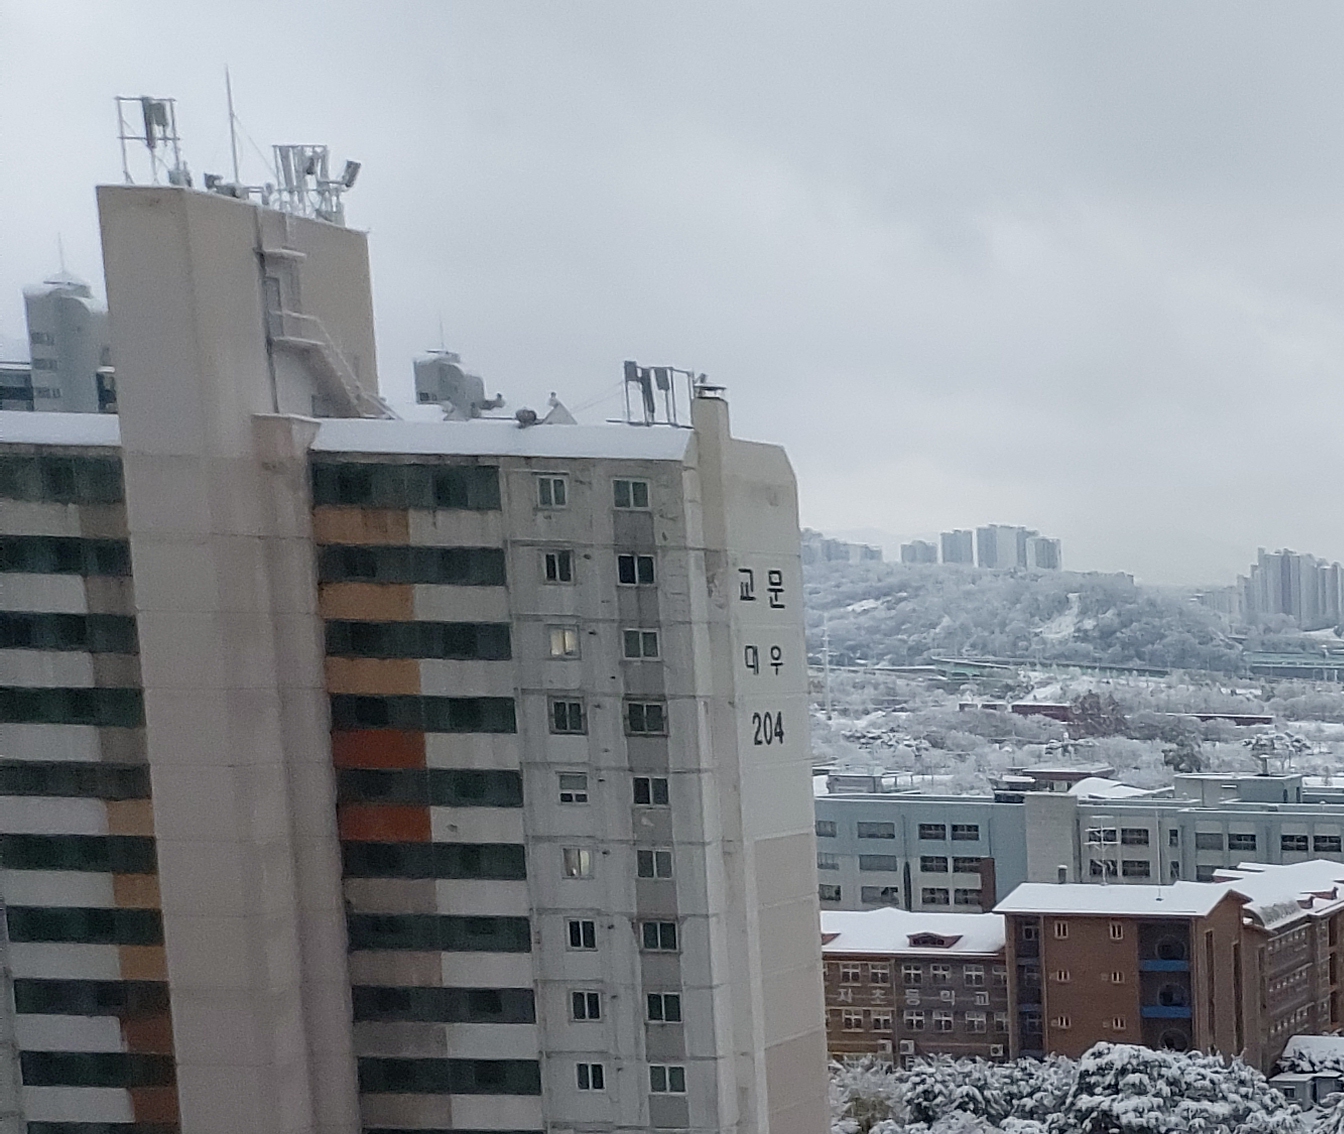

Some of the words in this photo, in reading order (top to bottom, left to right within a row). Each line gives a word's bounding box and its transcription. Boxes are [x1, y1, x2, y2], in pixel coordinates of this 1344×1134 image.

[738, 568, 785, 609] 교문
[745, 645, 783, 675] 대우
[752, 711, 784, 745] 204
